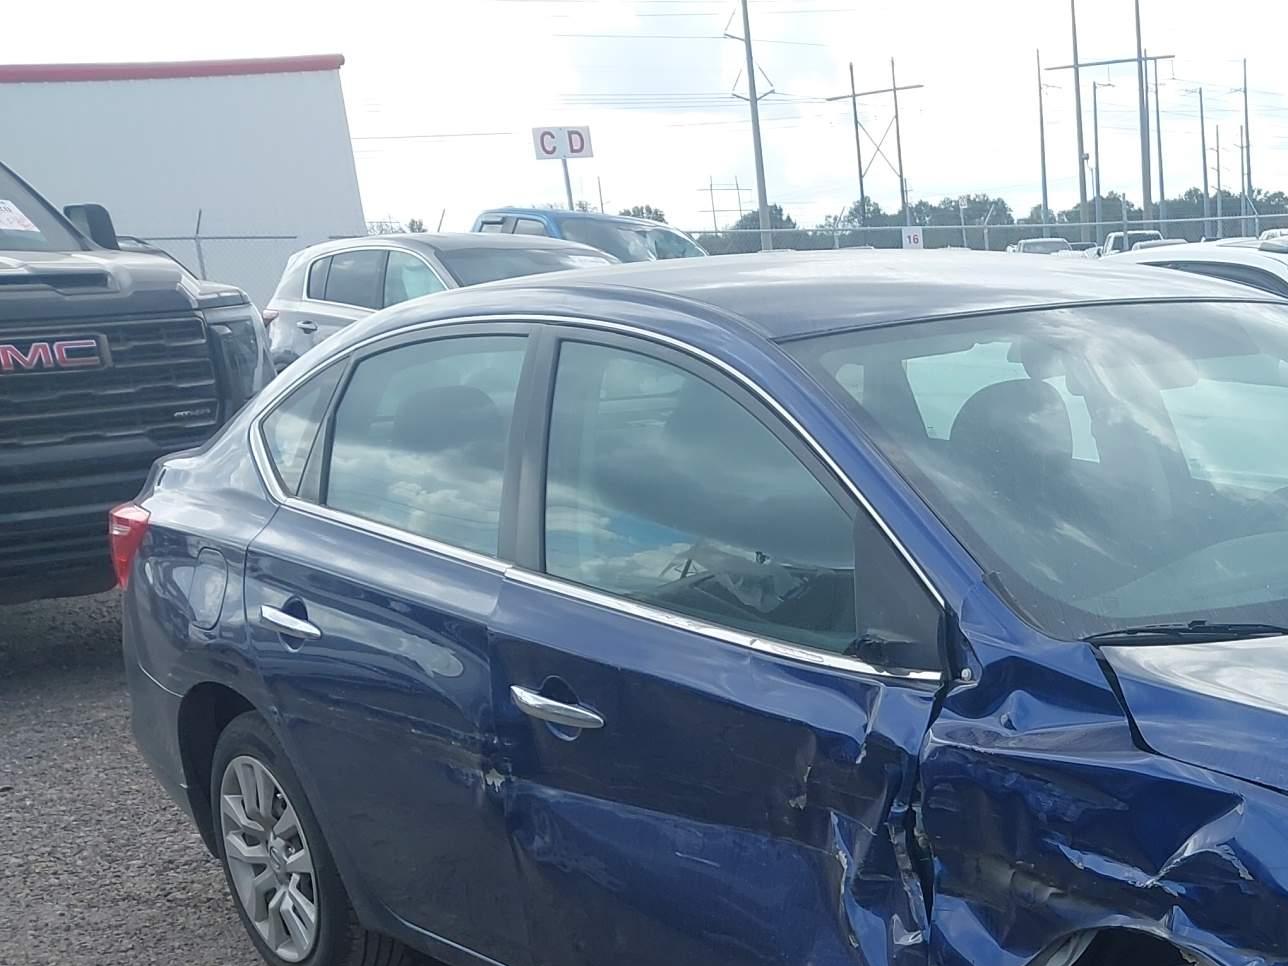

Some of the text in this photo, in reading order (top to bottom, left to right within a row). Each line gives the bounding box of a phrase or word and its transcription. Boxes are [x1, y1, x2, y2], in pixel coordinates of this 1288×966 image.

[540, 129, 585, 155] C D
[906, 234, 920, 245] 16
[0, 339, 100, 371] MC
